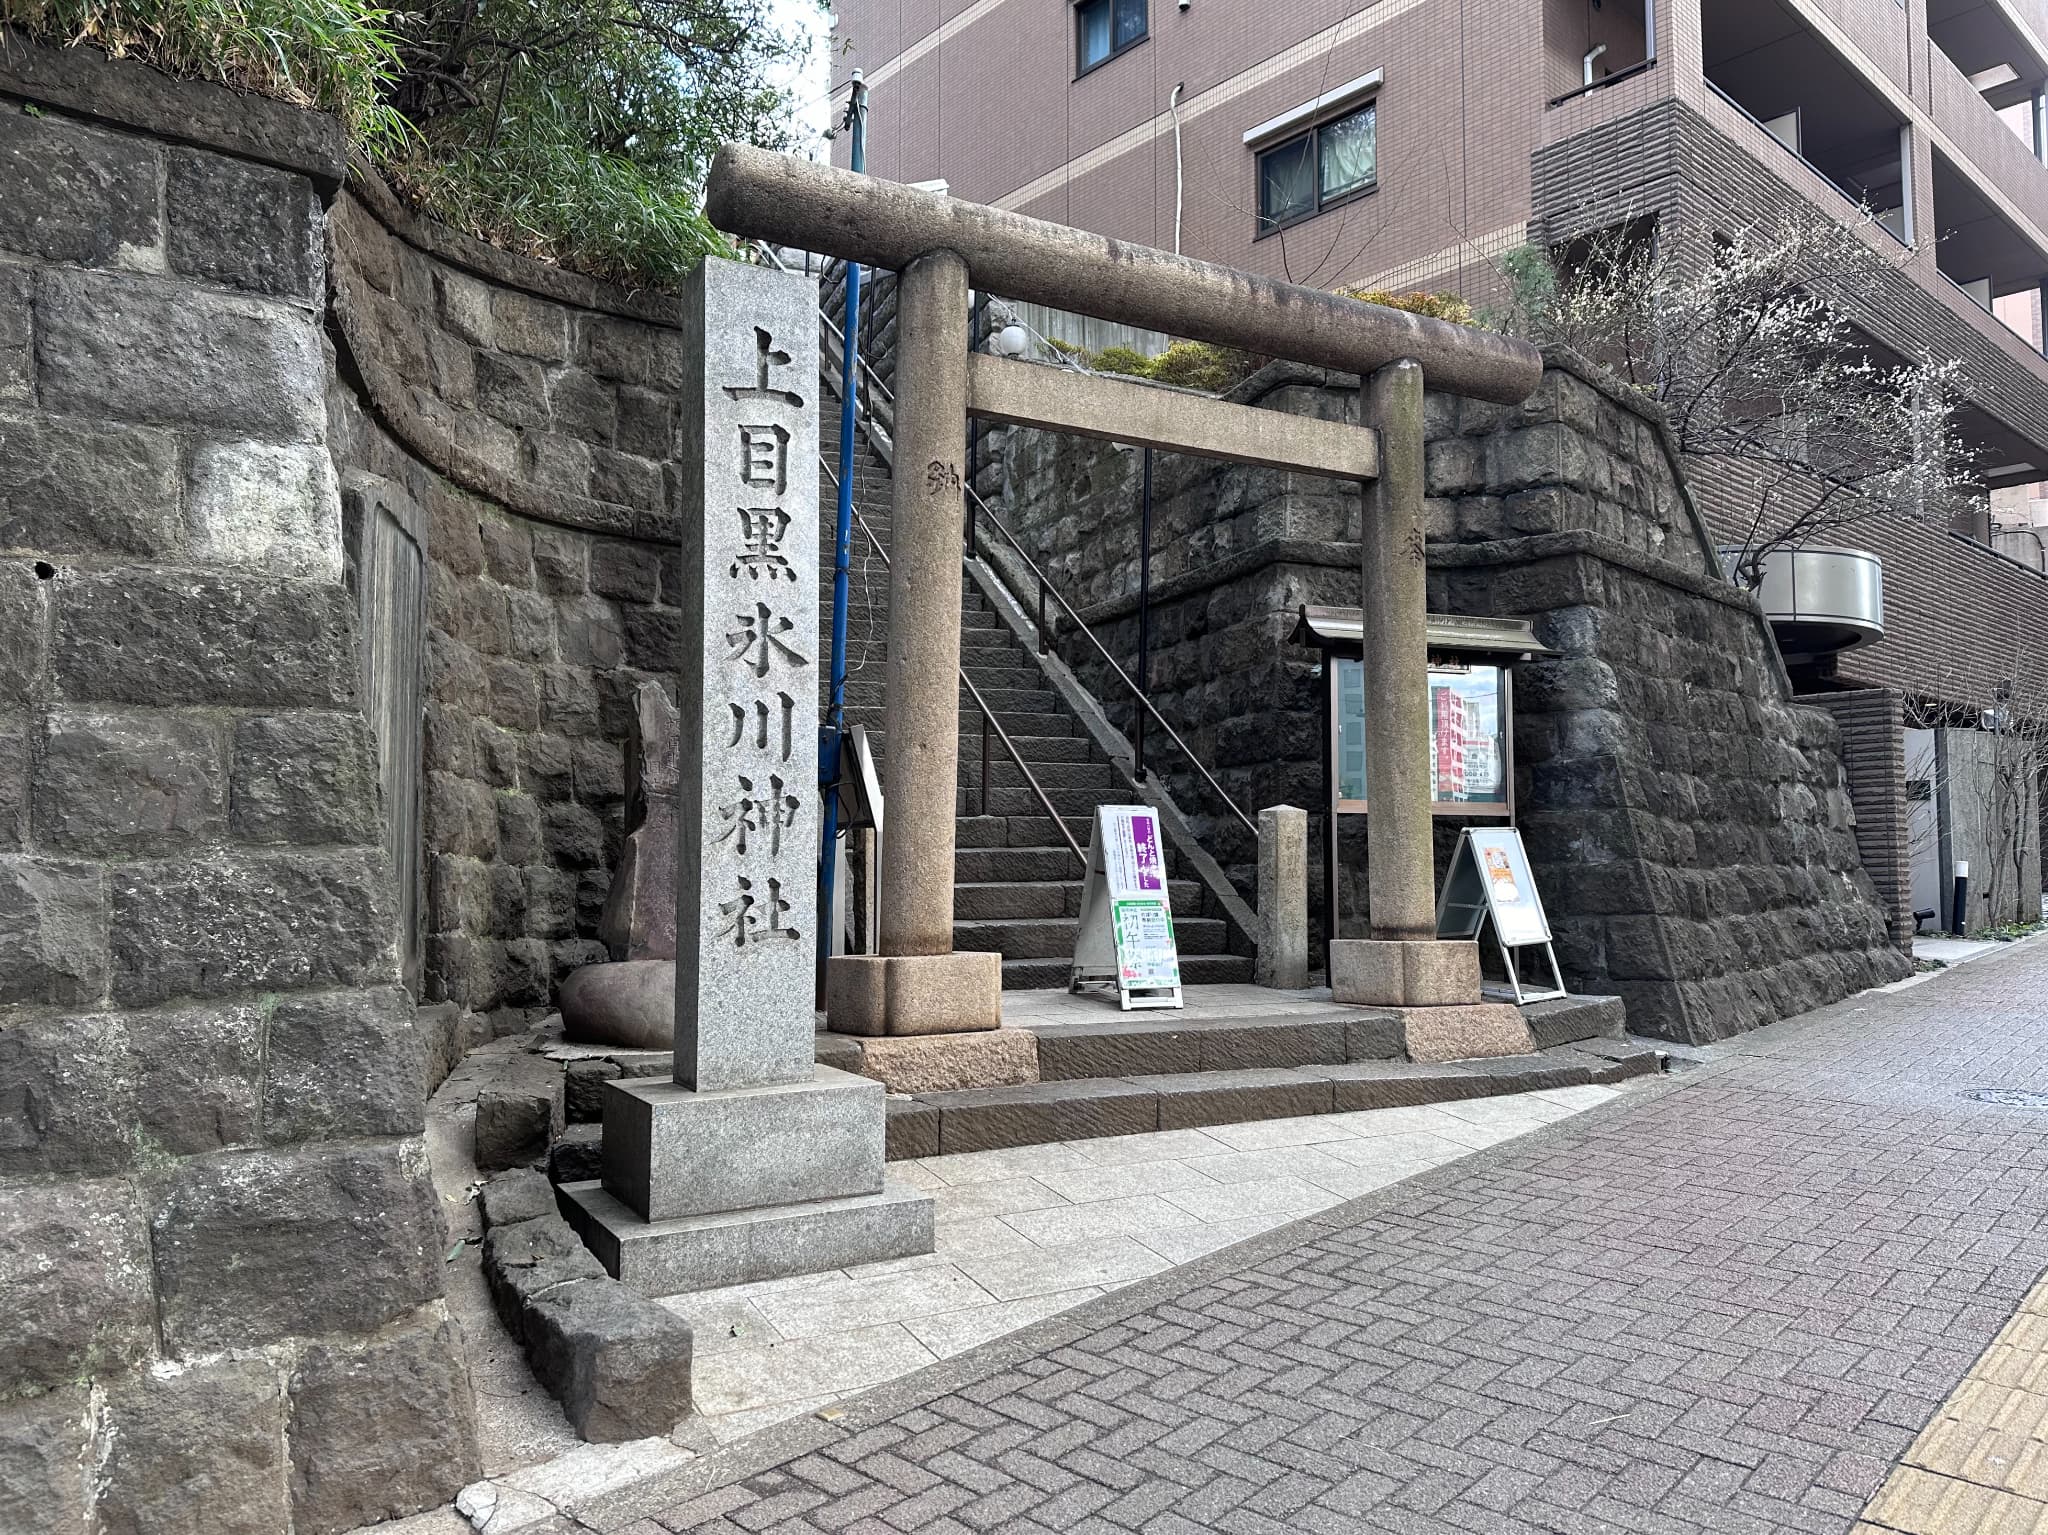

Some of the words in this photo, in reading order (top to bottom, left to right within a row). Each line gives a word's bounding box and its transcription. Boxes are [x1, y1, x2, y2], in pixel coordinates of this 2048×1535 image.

[710, 325, 810, 947] 上目黒氷川神社
